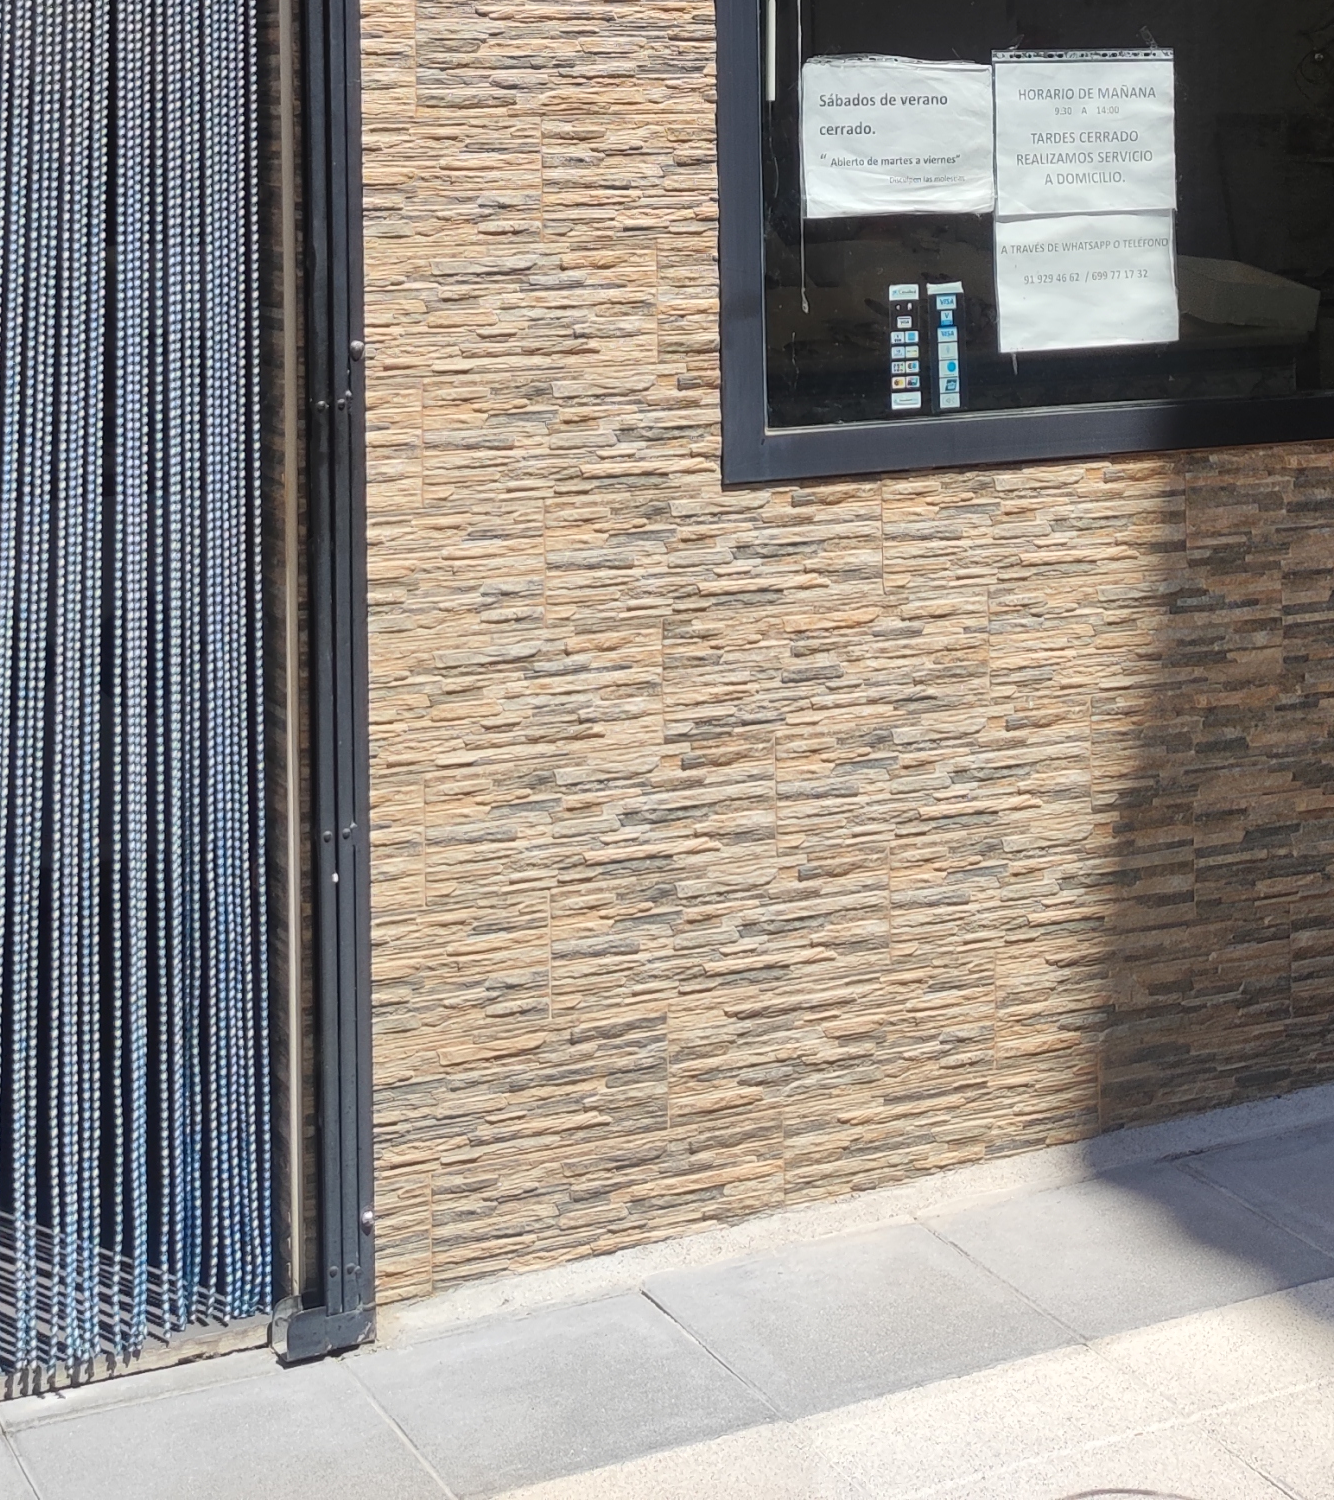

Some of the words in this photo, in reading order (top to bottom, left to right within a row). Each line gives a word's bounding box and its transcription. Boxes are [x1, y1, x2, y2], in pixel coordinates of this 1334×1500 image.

[819, 93, 876, 107] Sábados
[880, 93, 897, 106] de
[900, 95, 948, 106] verano
[1018, 88, 1075, 101] HORARIO
[1078, 88, 1094, 100] DE
[1098, 84, 1157, 100] MAÑANA
[1081, 106, 1088, 115] A
[1096, 105, 1120, 115] 14:00
[819, 121, 876, 136] cerrado.
[1031, 132, 1076, 145] TARDES
[1079, 130, 1139, 143] CERRADO
[830, 157, 865, 167] Abierto
[867, 156, 879, 166] de
[881, 156, 913, 166] martes
[915, 157, 921, 165] a
[1017, 152, 1095, 166] REALIZAMOS
[1097, 150, 1153, 163] SERVICIO
[923, 175, 933, 183] las
[1044, 173, 1054, 186] A
[1056, 171, 1126, 185] DOMICILIO.
[1000, 245, 1008, 255] A
[1010, 242, 1045, 254] TRAVÉS
[1047, 243, 1060, 252] DE
[1061, 240, 1112, 252] WHATSAPP
[1113, 239, 1121, 249] O
[1123, 236, 1169, 248] TELÉFONO
[1023, 275, 1035, 285] 91
[1037, 273, 1054, 284] 929
[1056, 273, 1067, 282] 46
[1069, 272, 1080, 282] 62
[1091, 271, 1108, 281] 699
[1110, 270, 1121, 280] 77
[1124, 269, 1135, 279] 17
[1136, 269, 1148, 278] 32
